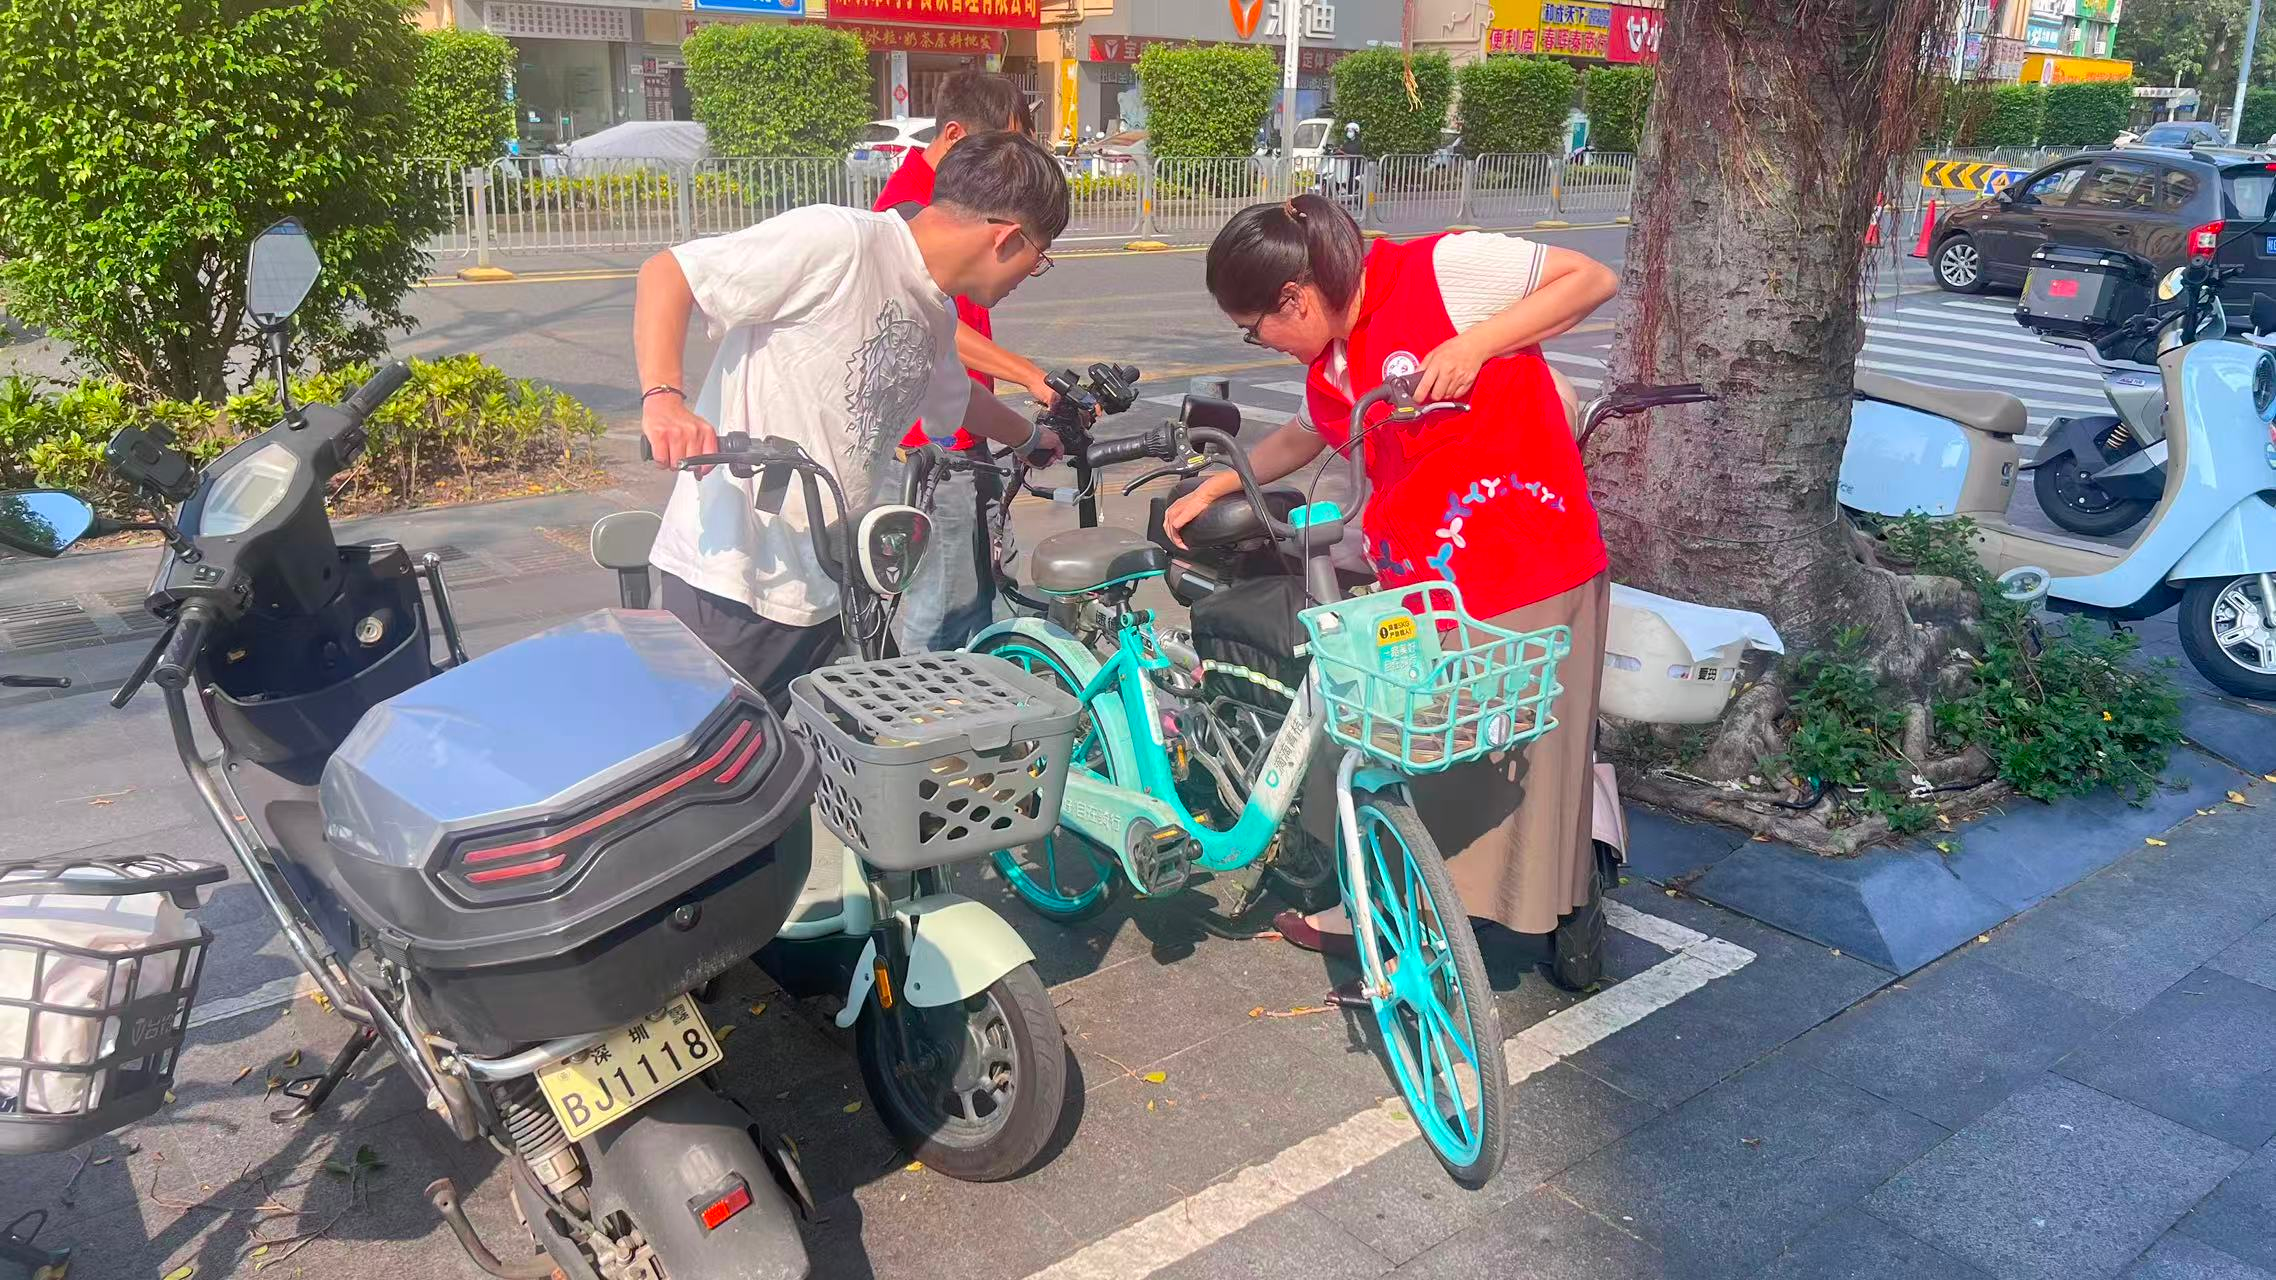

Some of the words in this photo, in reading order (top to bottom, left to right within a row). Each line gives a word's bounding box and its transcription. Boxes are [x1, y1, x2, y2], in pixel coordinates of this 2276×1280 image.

[1490, 28, 1536, 52] 便利店
[590, 1023, 650, 1066] 深圳
[561, 1028, 708, 1128] BJ1118
